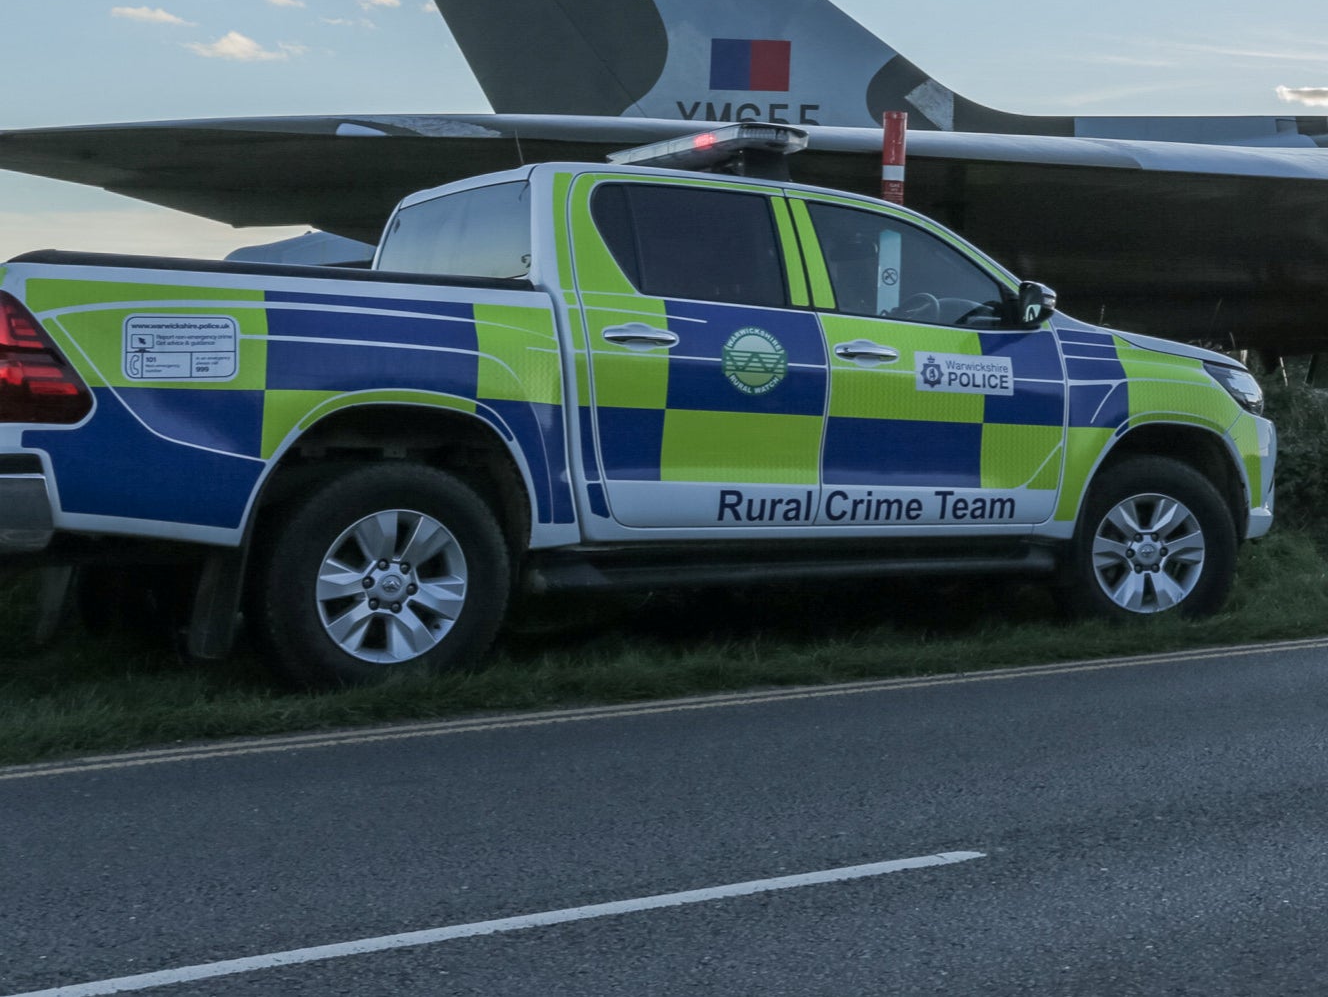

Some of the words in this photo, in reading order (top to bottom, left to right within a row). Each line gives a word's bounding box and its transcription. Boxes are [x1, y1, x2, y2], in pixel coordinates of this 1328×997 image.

[726, 328, 782, 351] WARWICKSHIRE
[945, 360, 1009, 374] Warwickshire
[729, 374, 752, 394] RURAL
[753, 377, 780, 394] WATCH
[947, 371, 1009, 390] POLICE
[716, 489, 813, 522] Rural
[824, 490, 923, 522] Crime
[934, 490, 1016, 520] Team
